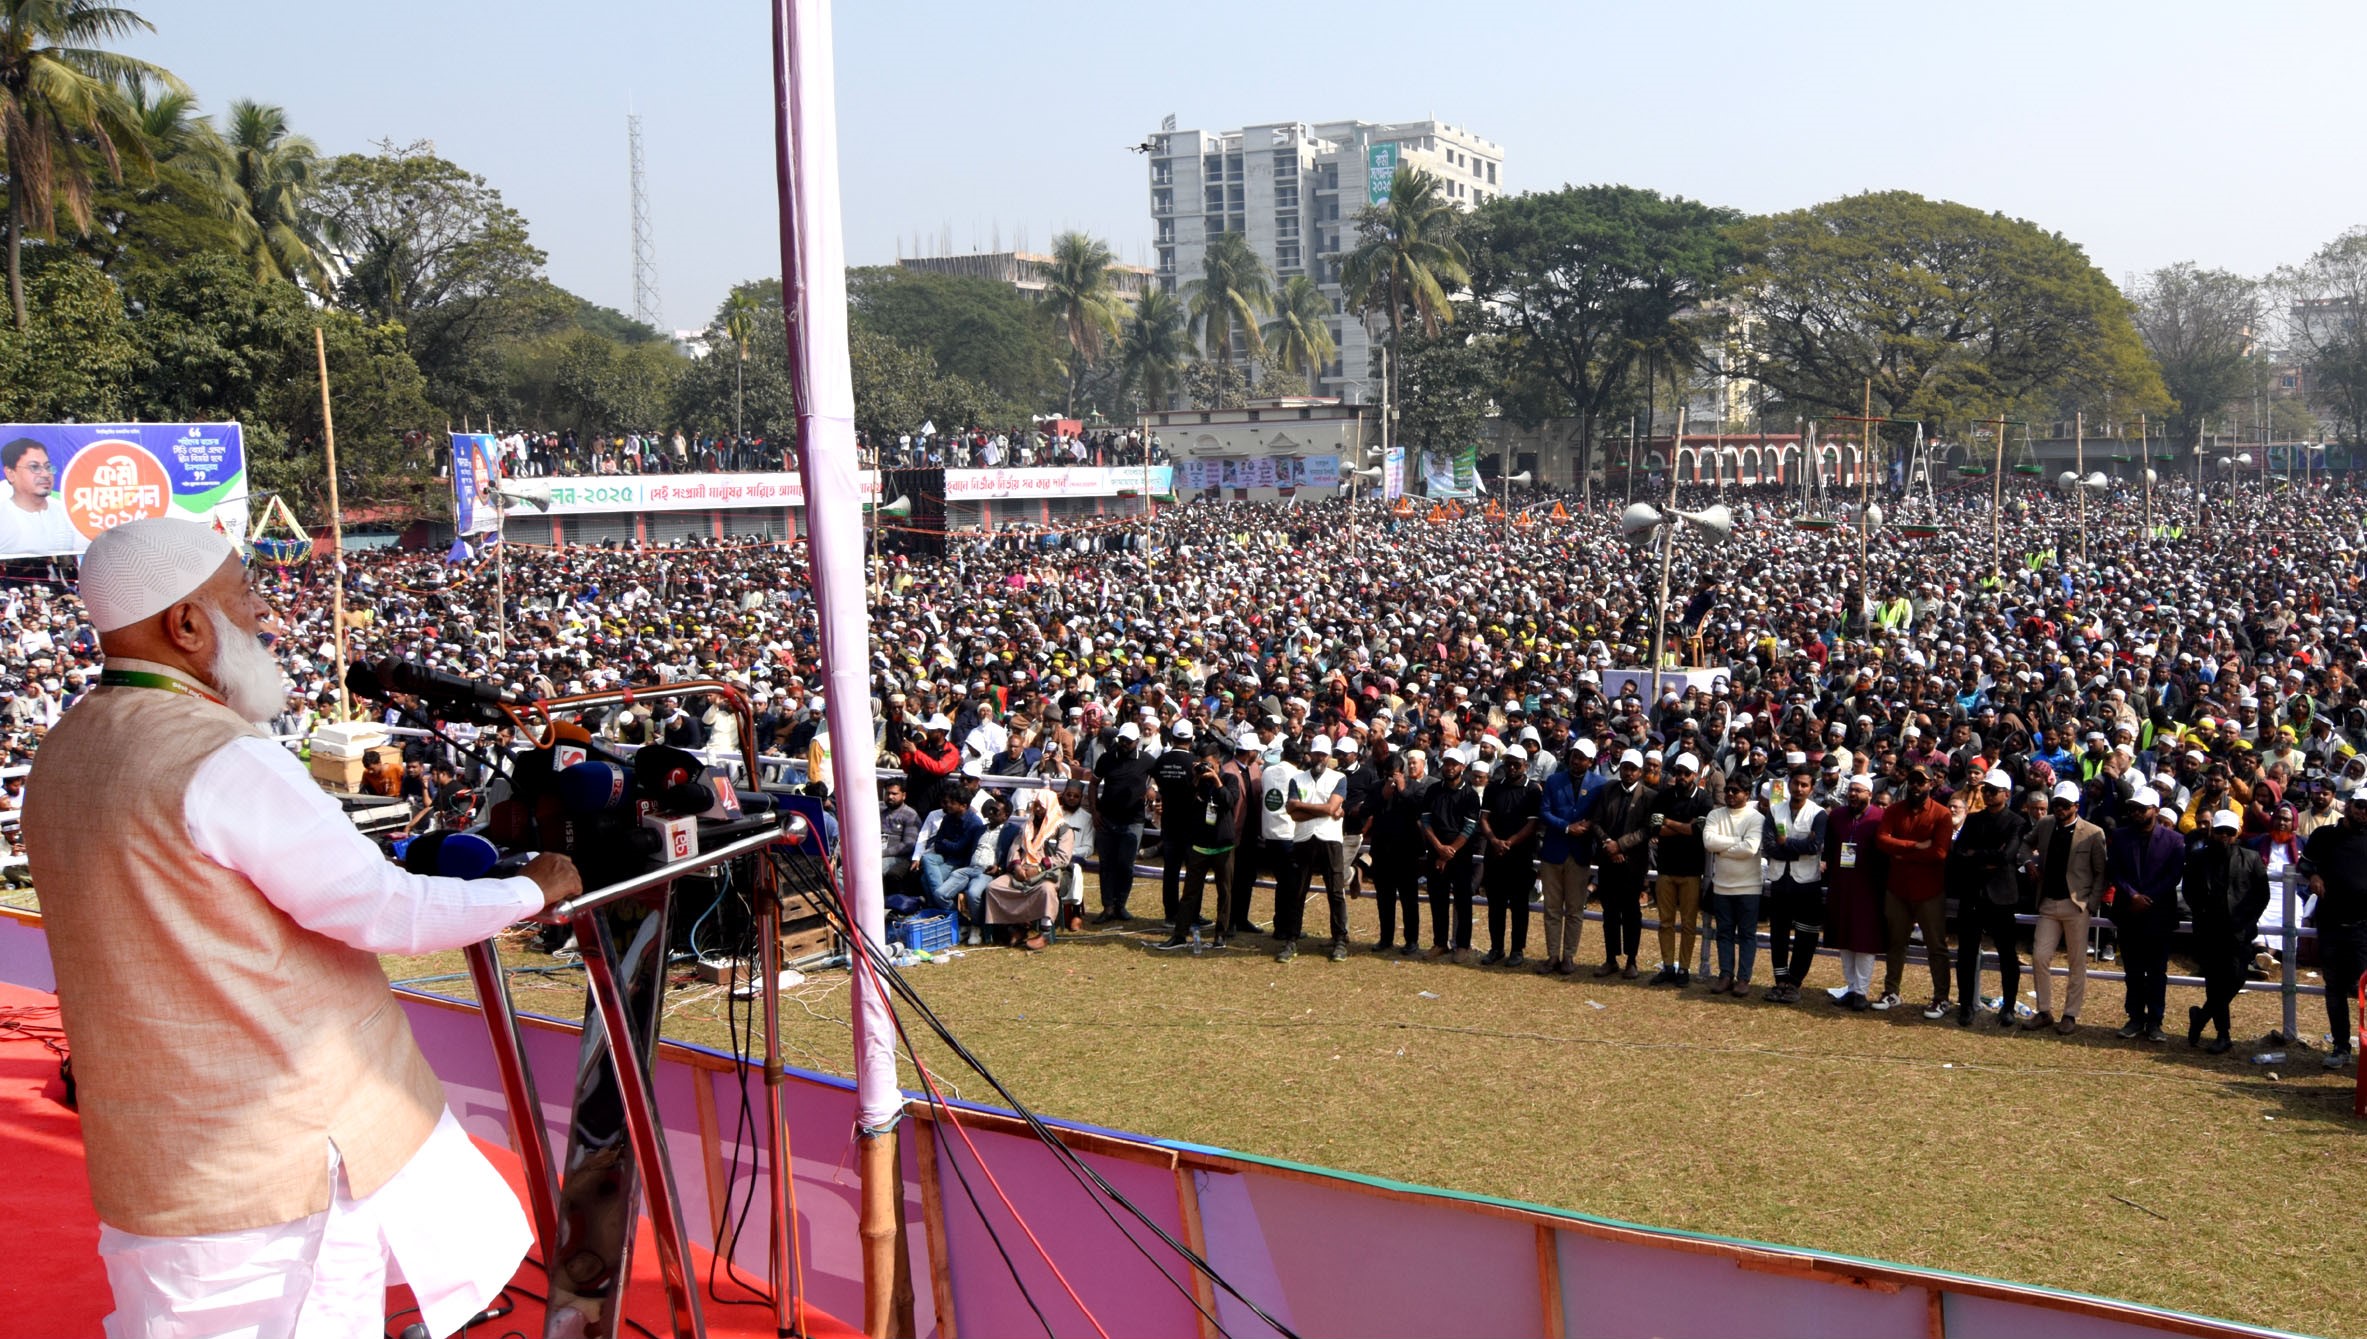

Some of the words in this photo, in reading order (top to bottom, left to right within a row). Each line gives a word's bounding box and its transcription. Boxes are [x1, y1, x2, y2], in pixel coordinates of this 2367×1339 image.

[70, 485, 160, 514] সম্মেলন
[650, 485, 669, 501] সেই
[672, 483, 706, 499] সংগ্রামী
[746, 482, 775, 499] সারিতে
[562, 751, 585, 768] S
